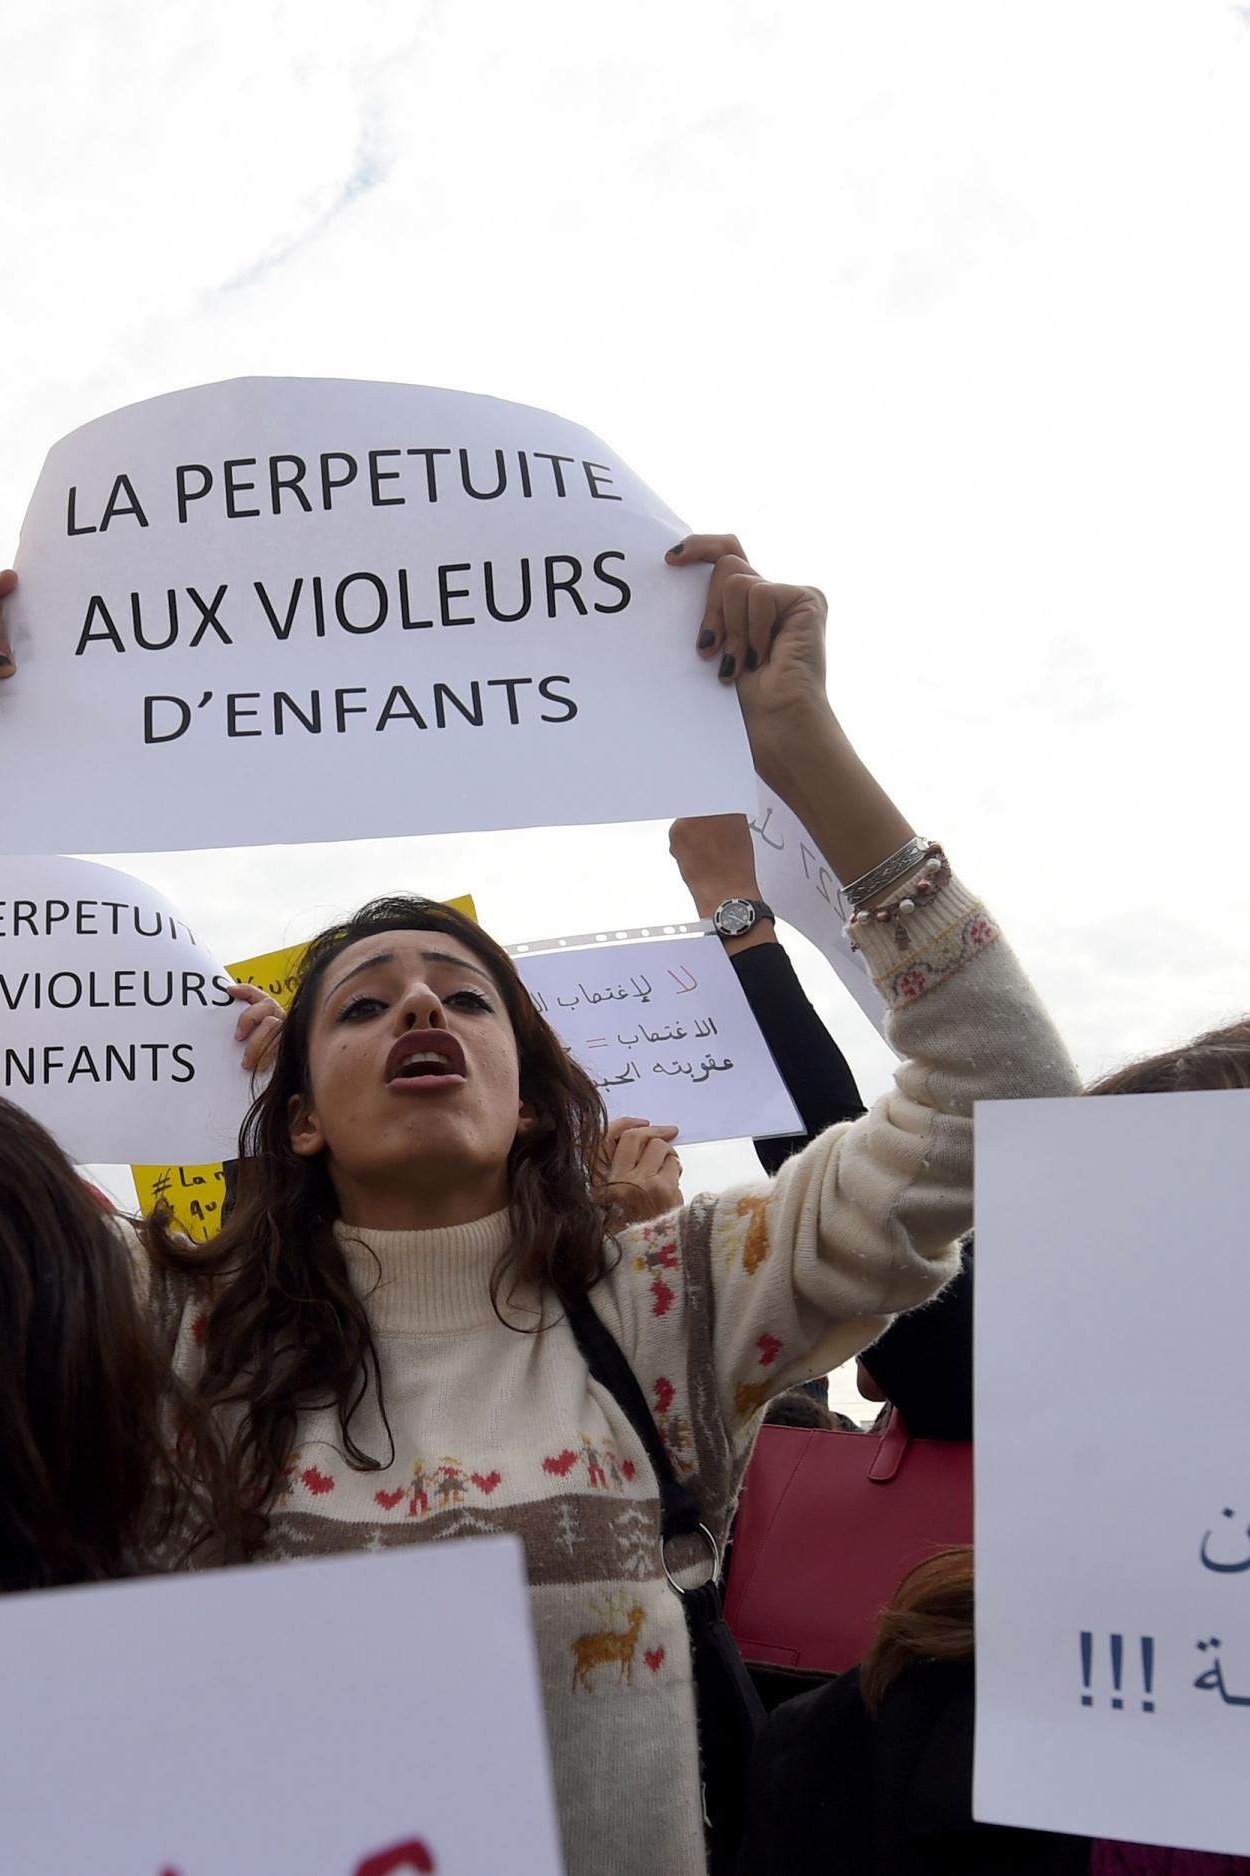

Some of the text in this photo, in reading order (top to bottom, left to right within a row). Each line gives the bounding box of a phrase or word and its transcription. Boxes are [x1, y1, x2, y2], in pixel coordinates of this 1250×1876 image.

[66, 447, 623, 537] LA PERPETUITE
[75, 550, 632, 657] AUX VIOLEURS
[143, 674, 579, 745] D’ENFANTS
[667, 965, 698, 995] لا
